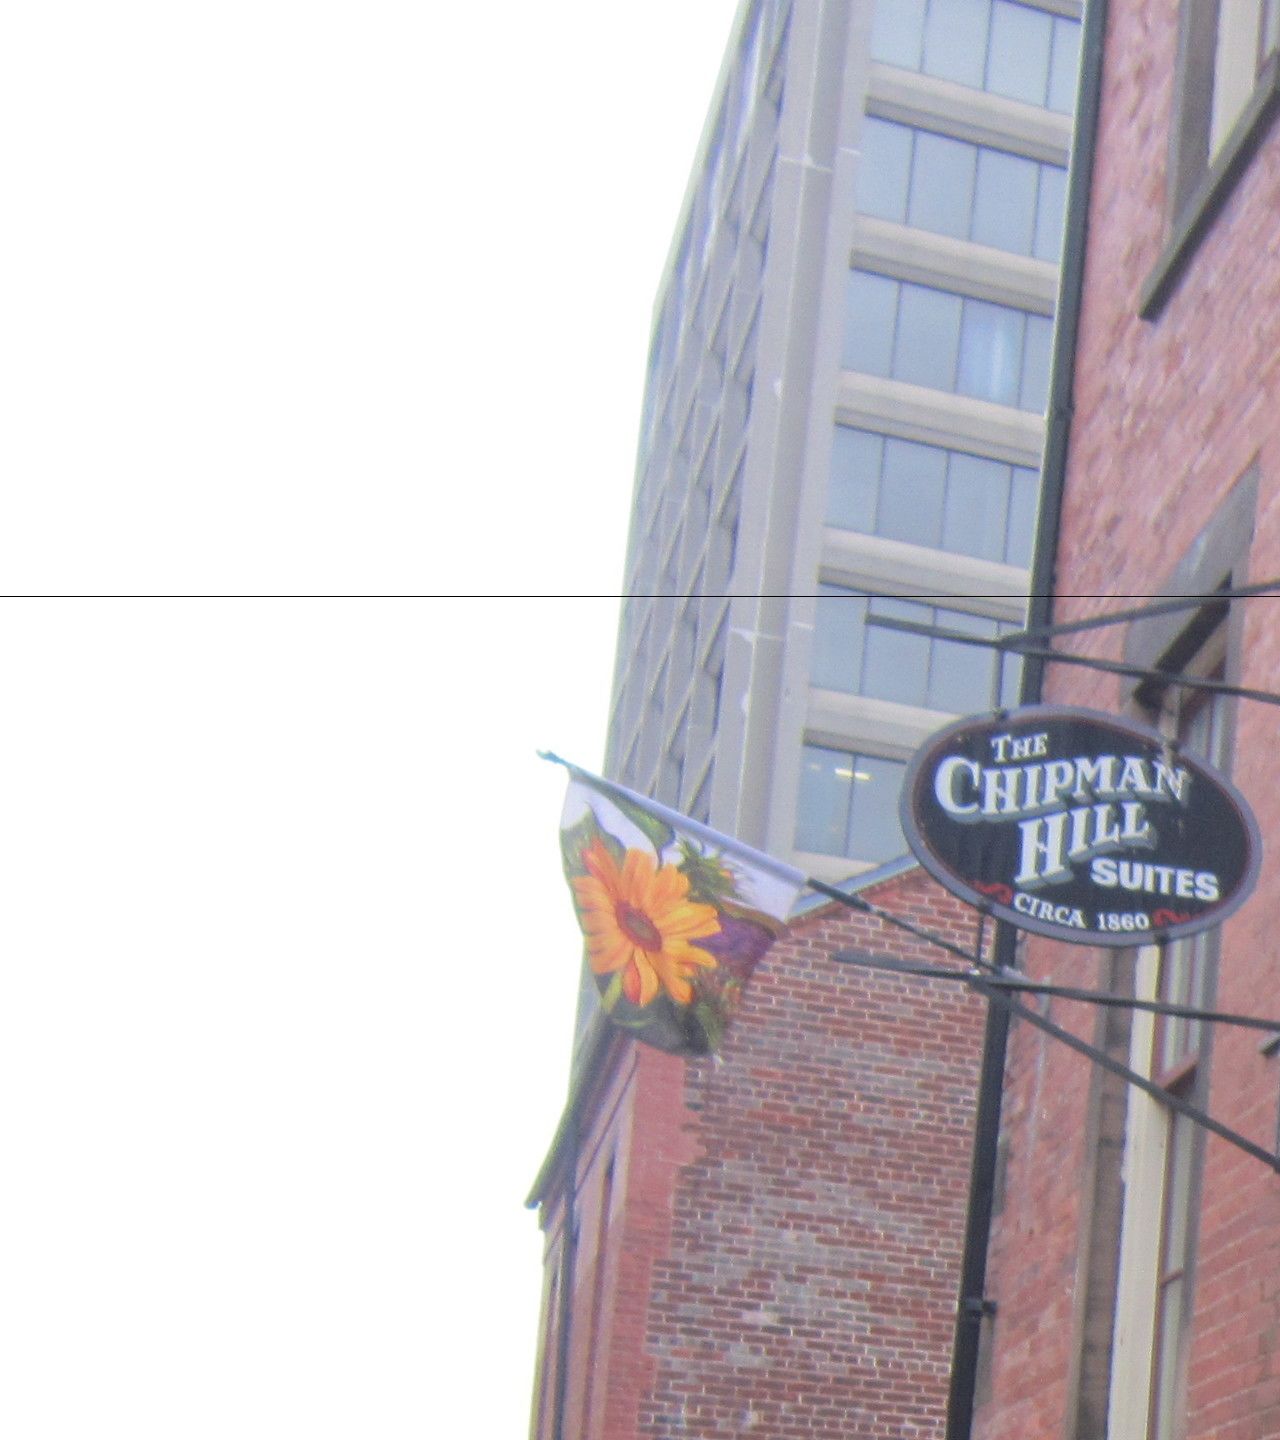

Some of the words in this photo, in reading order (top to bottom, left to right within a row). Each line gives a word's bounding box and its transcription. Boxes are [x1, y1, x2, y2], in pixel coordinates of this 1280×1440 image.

[991, 734, 1048, 763] THE
[935, 755, 1191, 816] CHIPMAN
[1015, 802, 1151, 885] HILL
[1092, 858, 1220, 901] SUITES
[1014, 893, 1086, 928] CIRCA
[1098, 913, 1150, 931] 1860
